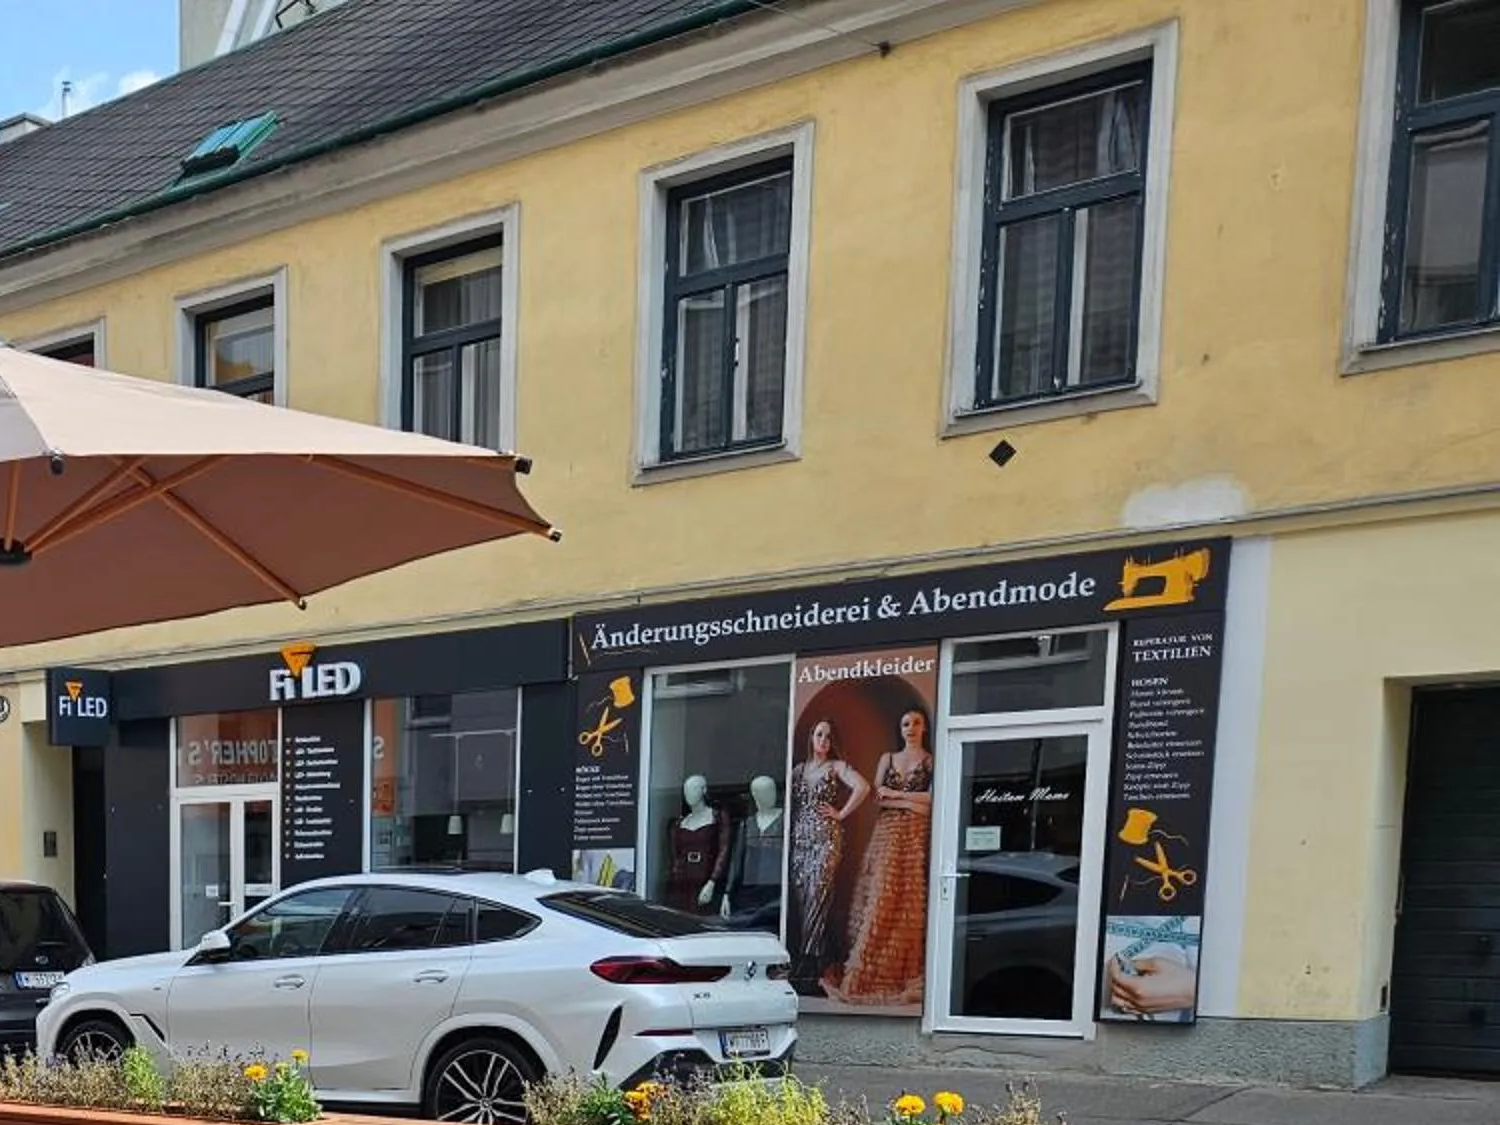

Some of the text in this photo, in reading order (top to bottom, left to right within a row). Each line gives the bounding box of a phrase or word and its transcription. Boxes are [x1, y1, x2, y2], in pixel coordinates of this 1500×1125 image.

[591, 571, 1097, 646] Änderungsschneiderei & Abendmode
[1132, 645, 1212, 663] TEXTILIEN
[798, 656, 935, 684] Abendkleider
